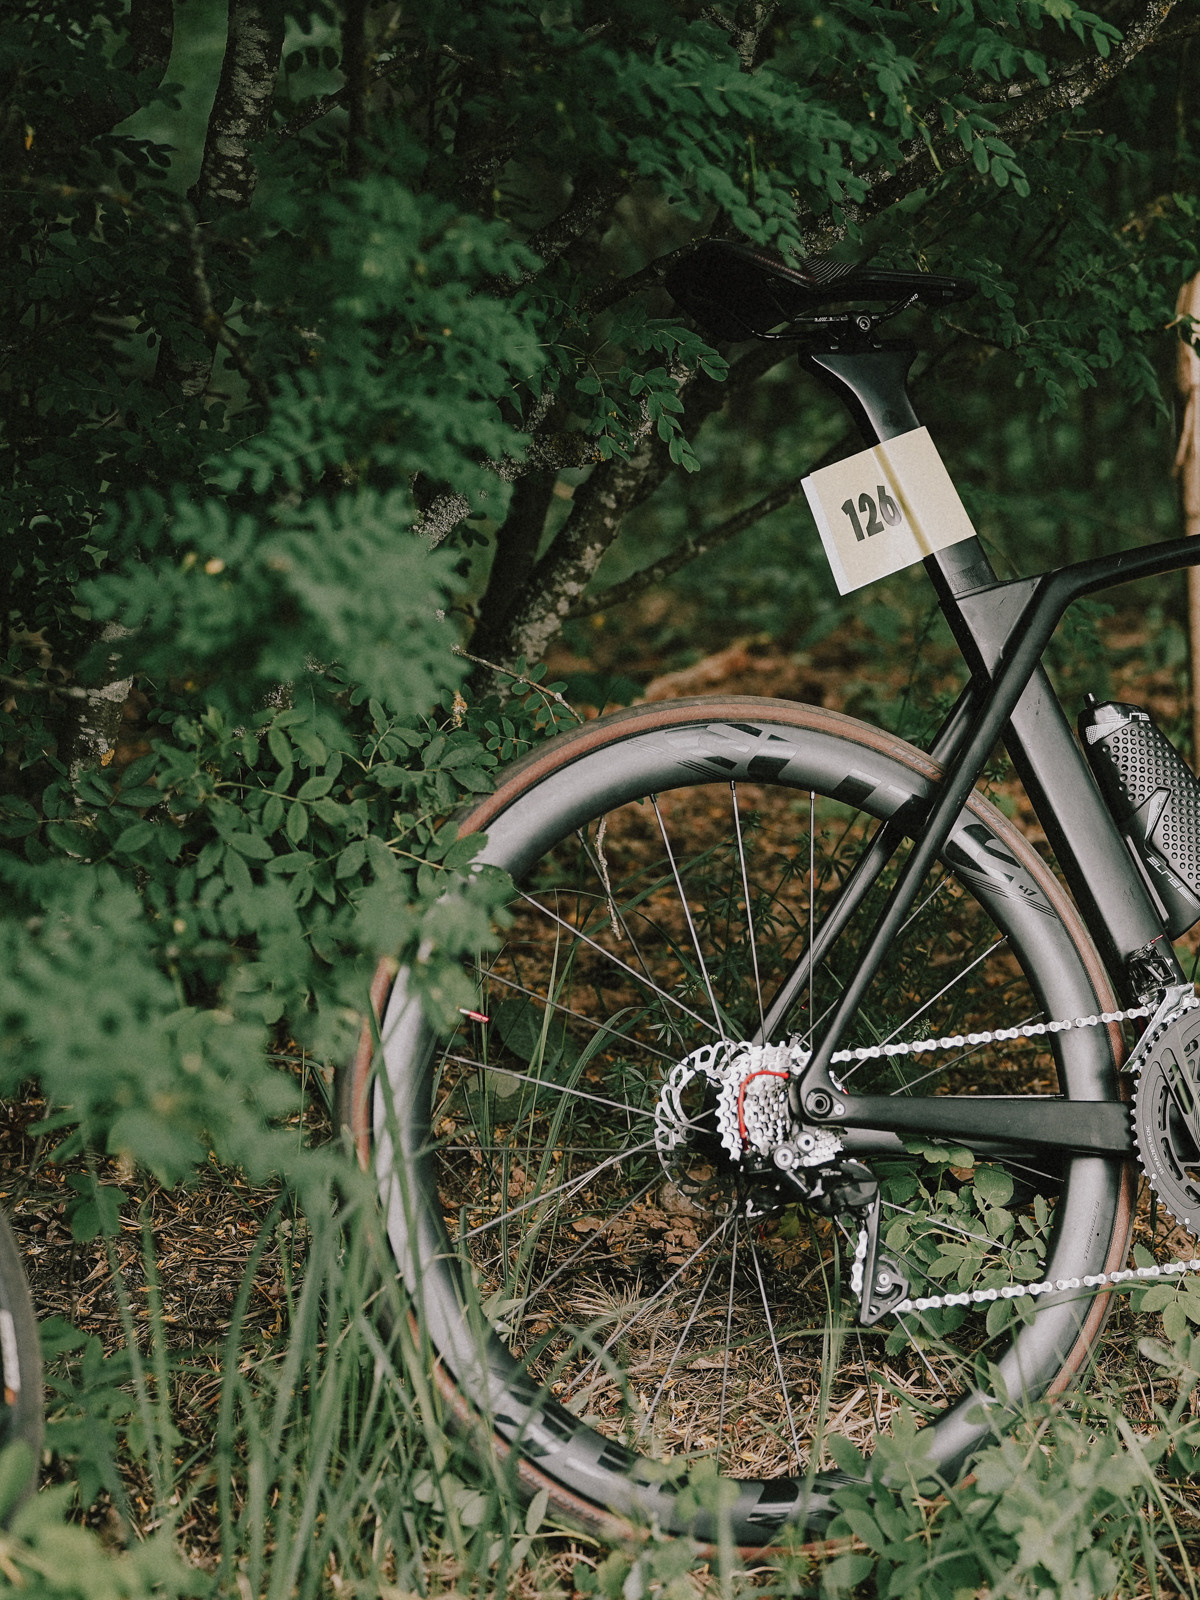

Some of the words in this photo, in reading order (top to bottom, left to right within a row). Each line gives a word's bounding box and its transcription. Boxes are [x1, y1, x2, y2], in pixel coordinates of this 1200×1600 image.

[841, 485, 903, 542] 126
[1105, 712, 1151, 722] ELITE
[1146, 856, 1182, 889] ELITE
